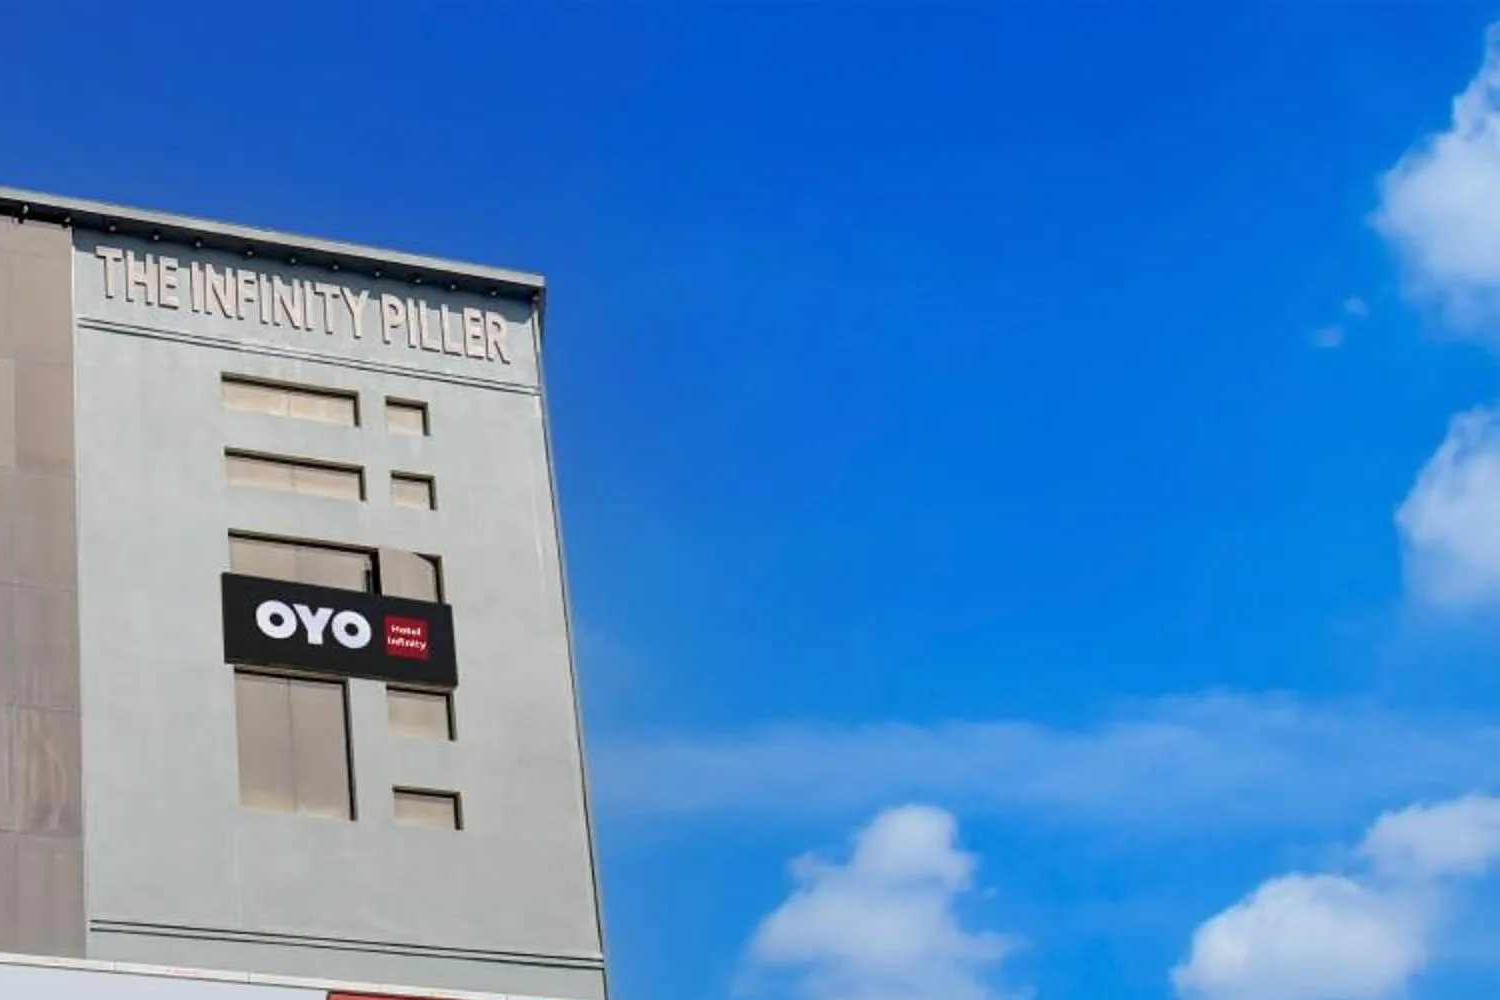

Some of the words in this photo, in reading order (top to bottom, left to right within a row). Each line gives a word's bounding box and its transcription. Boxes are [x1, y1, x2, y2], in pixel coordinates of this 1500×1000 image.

[95, 246, 179, 311] THE
[190, 262, 369, 339] INFINITY
[381, 294, 511, 364] PILLER
[255, 599, 372, 649] OYO
[390, 624, 421, 637] Hotel
